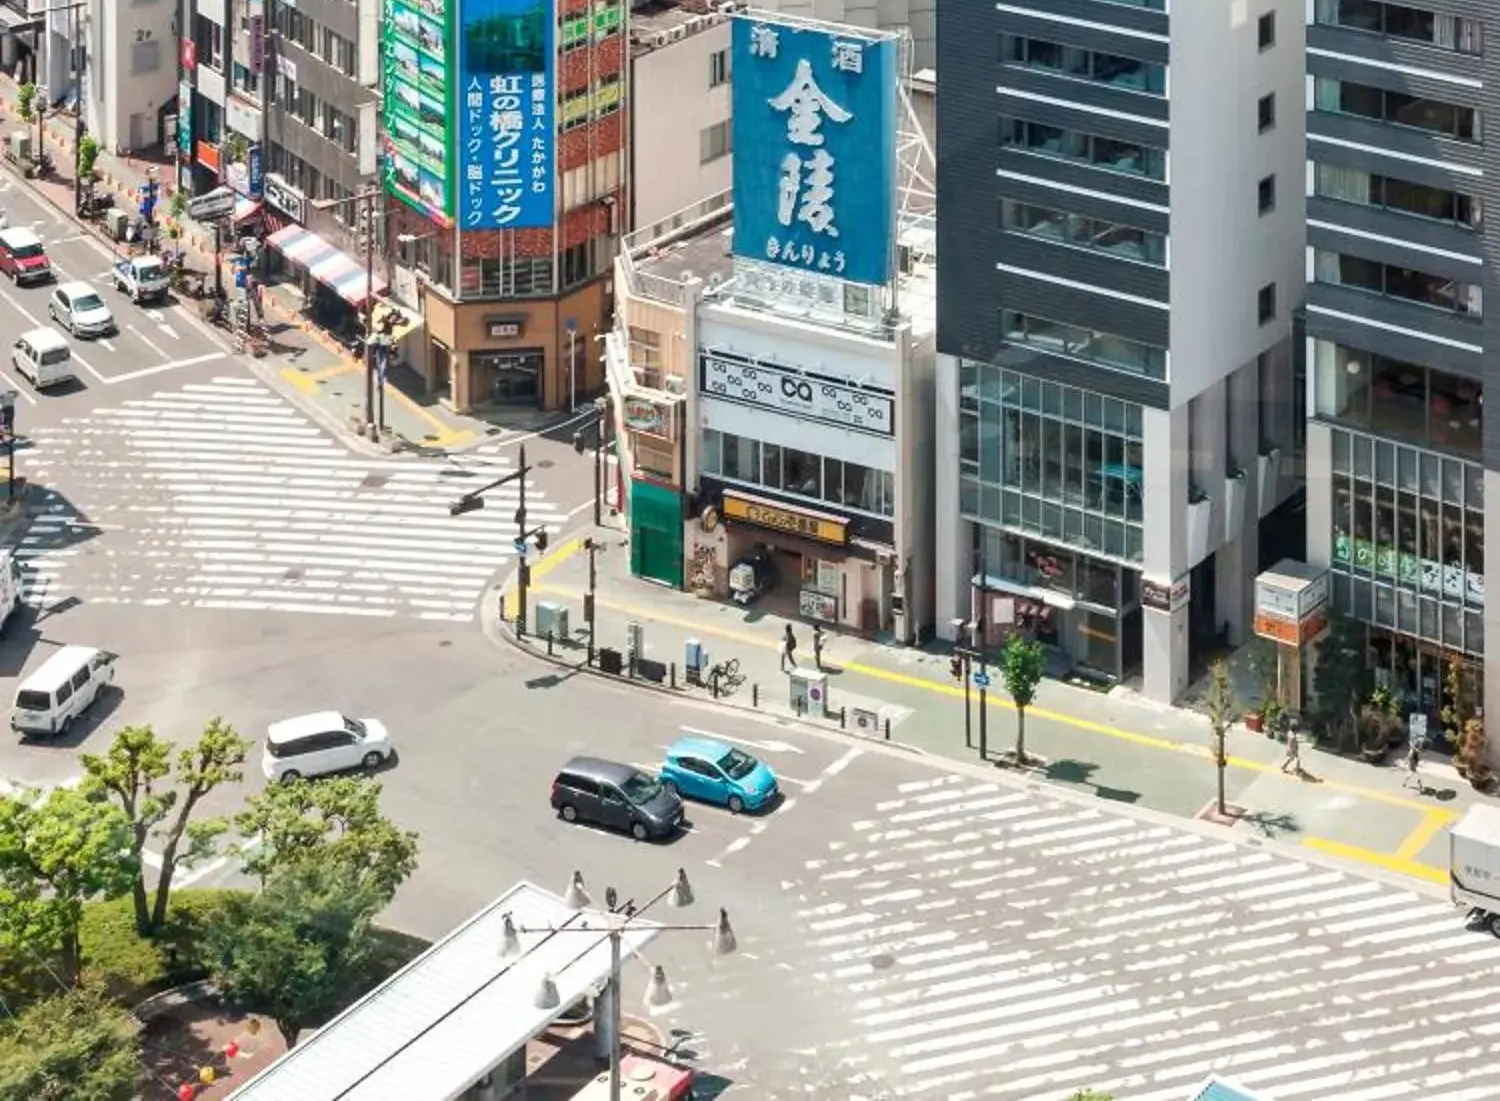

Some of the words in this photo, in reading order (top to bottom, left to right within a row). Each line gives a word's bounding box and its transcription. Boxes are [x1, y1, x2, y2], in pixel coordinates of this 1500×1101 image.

[135, 29, 152, 42] 2F
[467, 76, 483, 226] 人間ドック・脳ドック
[490, 75, 524, 224] 虹の橋クリニック
[531, 73, 546, 130] 医療法人
[768, 58, 854, 238] 金陵
[766, 236, 846, 273] きんりょう
